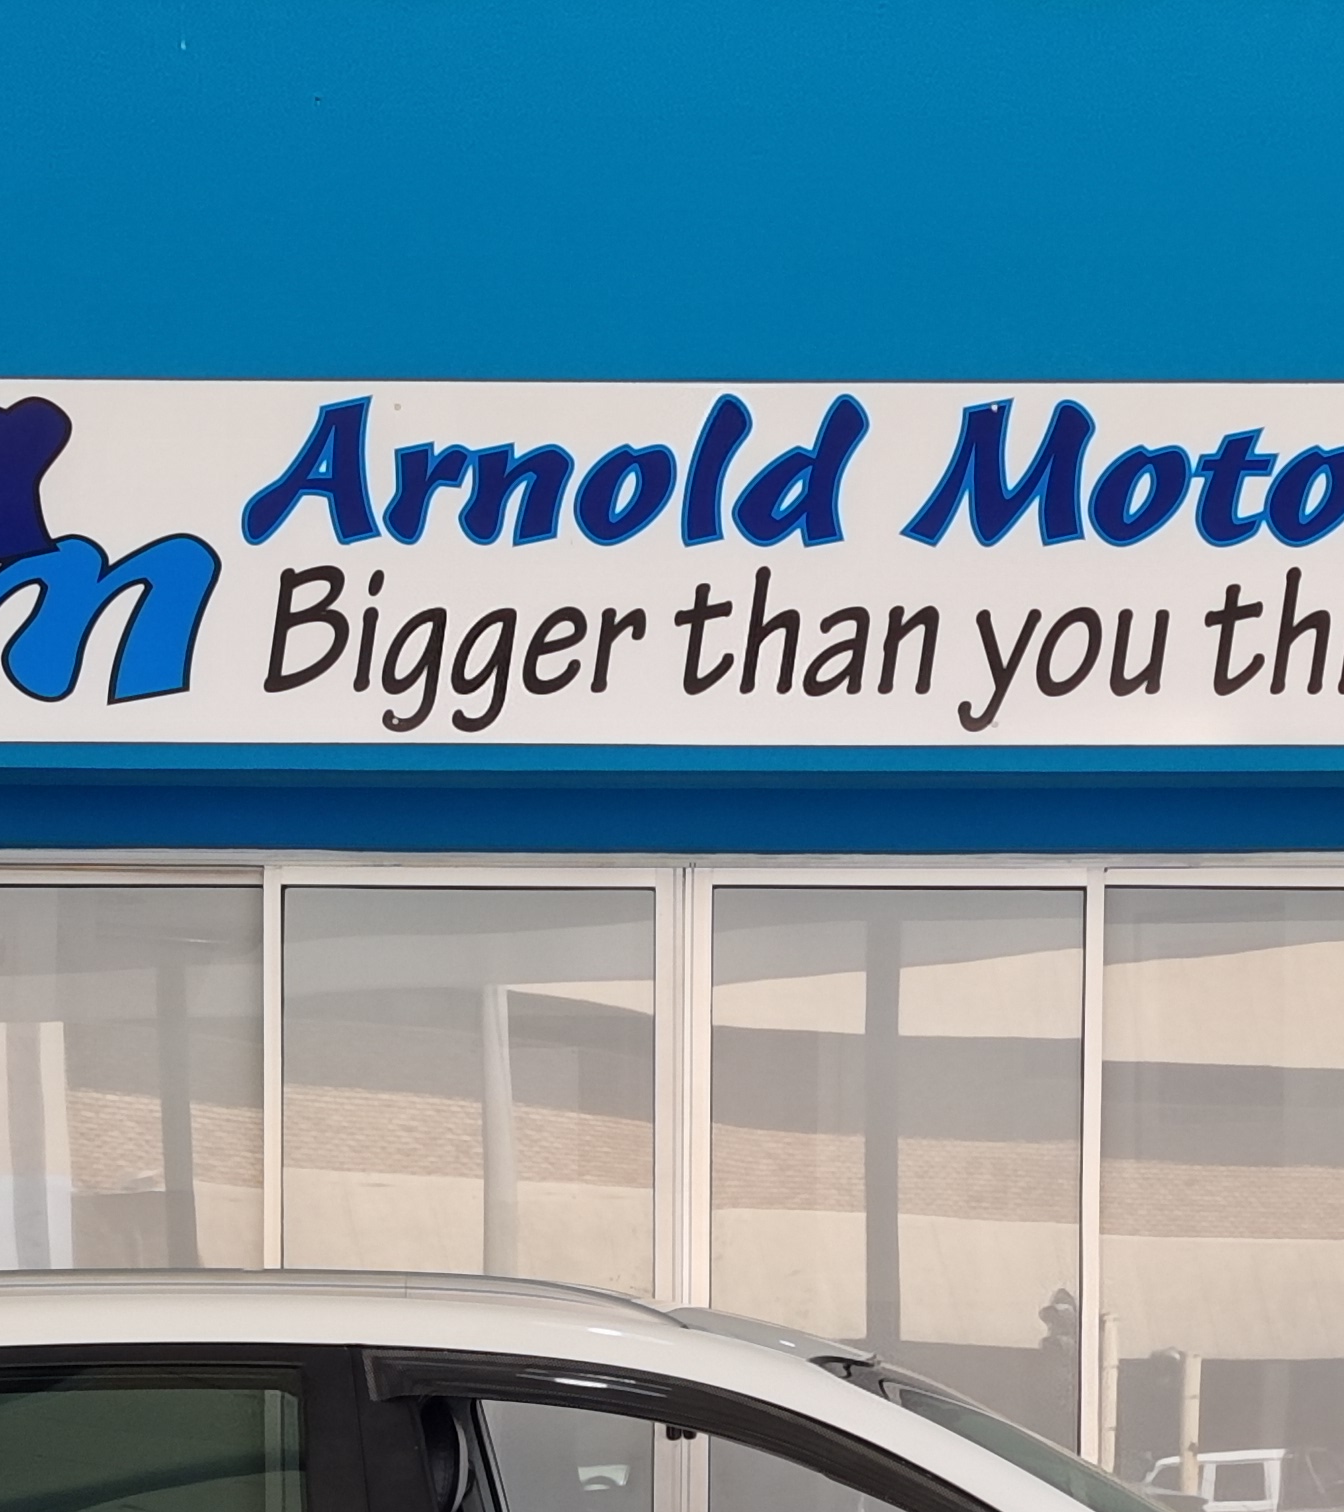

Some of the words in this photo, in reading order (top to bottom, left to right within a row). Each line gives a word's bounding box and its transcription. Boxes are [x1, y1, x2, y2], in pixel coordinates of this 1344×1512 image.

[242, 394, 870, 548] Arnold
[264, 566, 646, 732] Bigger
[675, 567, 941, 697] than
[958, 607, 1170, 732] you
